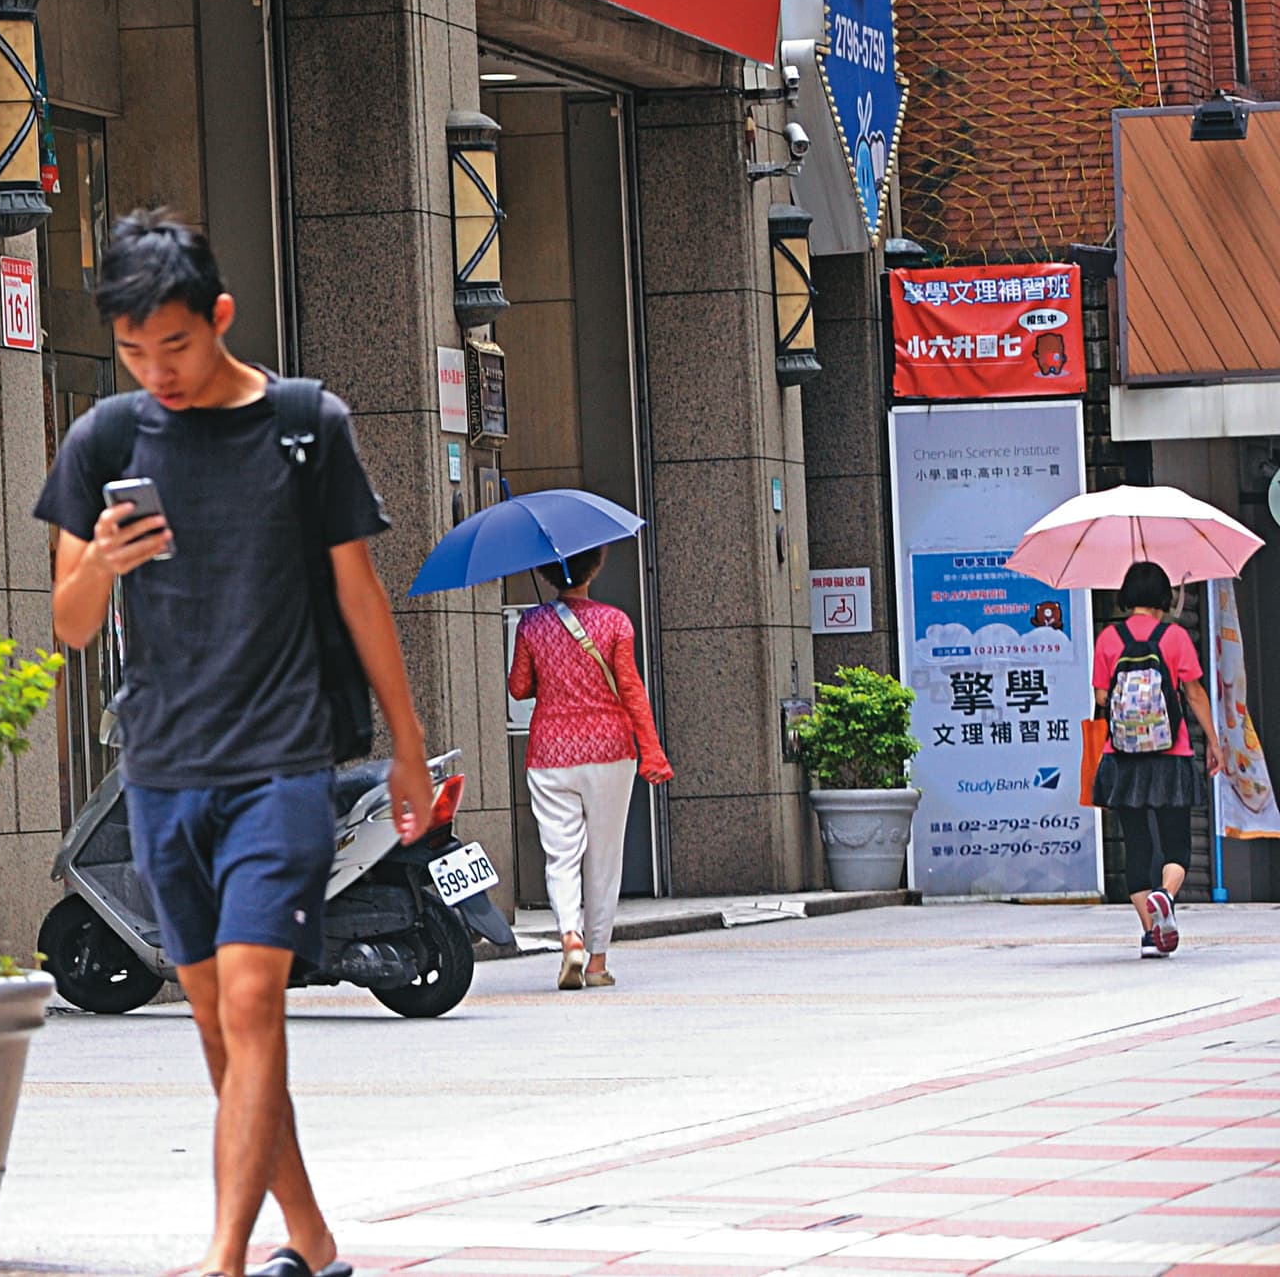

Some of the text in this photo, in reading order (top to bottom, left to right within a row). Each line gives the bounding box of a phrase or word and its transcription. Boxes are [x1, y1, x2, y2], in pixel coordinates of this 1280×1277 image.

[834, 13, 886, 75] 2796-5759
[8, 293, 31, 334] 161
[907, 334, 1023, 359] 小六升國七
[966, 446, 1011, 459] Science
[1014, 444, 1061, 457] Institute
[950, 669, 1049, 716] 擎學
[933, 719, 1070, 747] 文理補習班
[956, 778, 1030, 795] StudyBank
[958, 814, 1081, 833] 02-2792-6615
[959, 840, 1082, 857] 02-2796-5759
